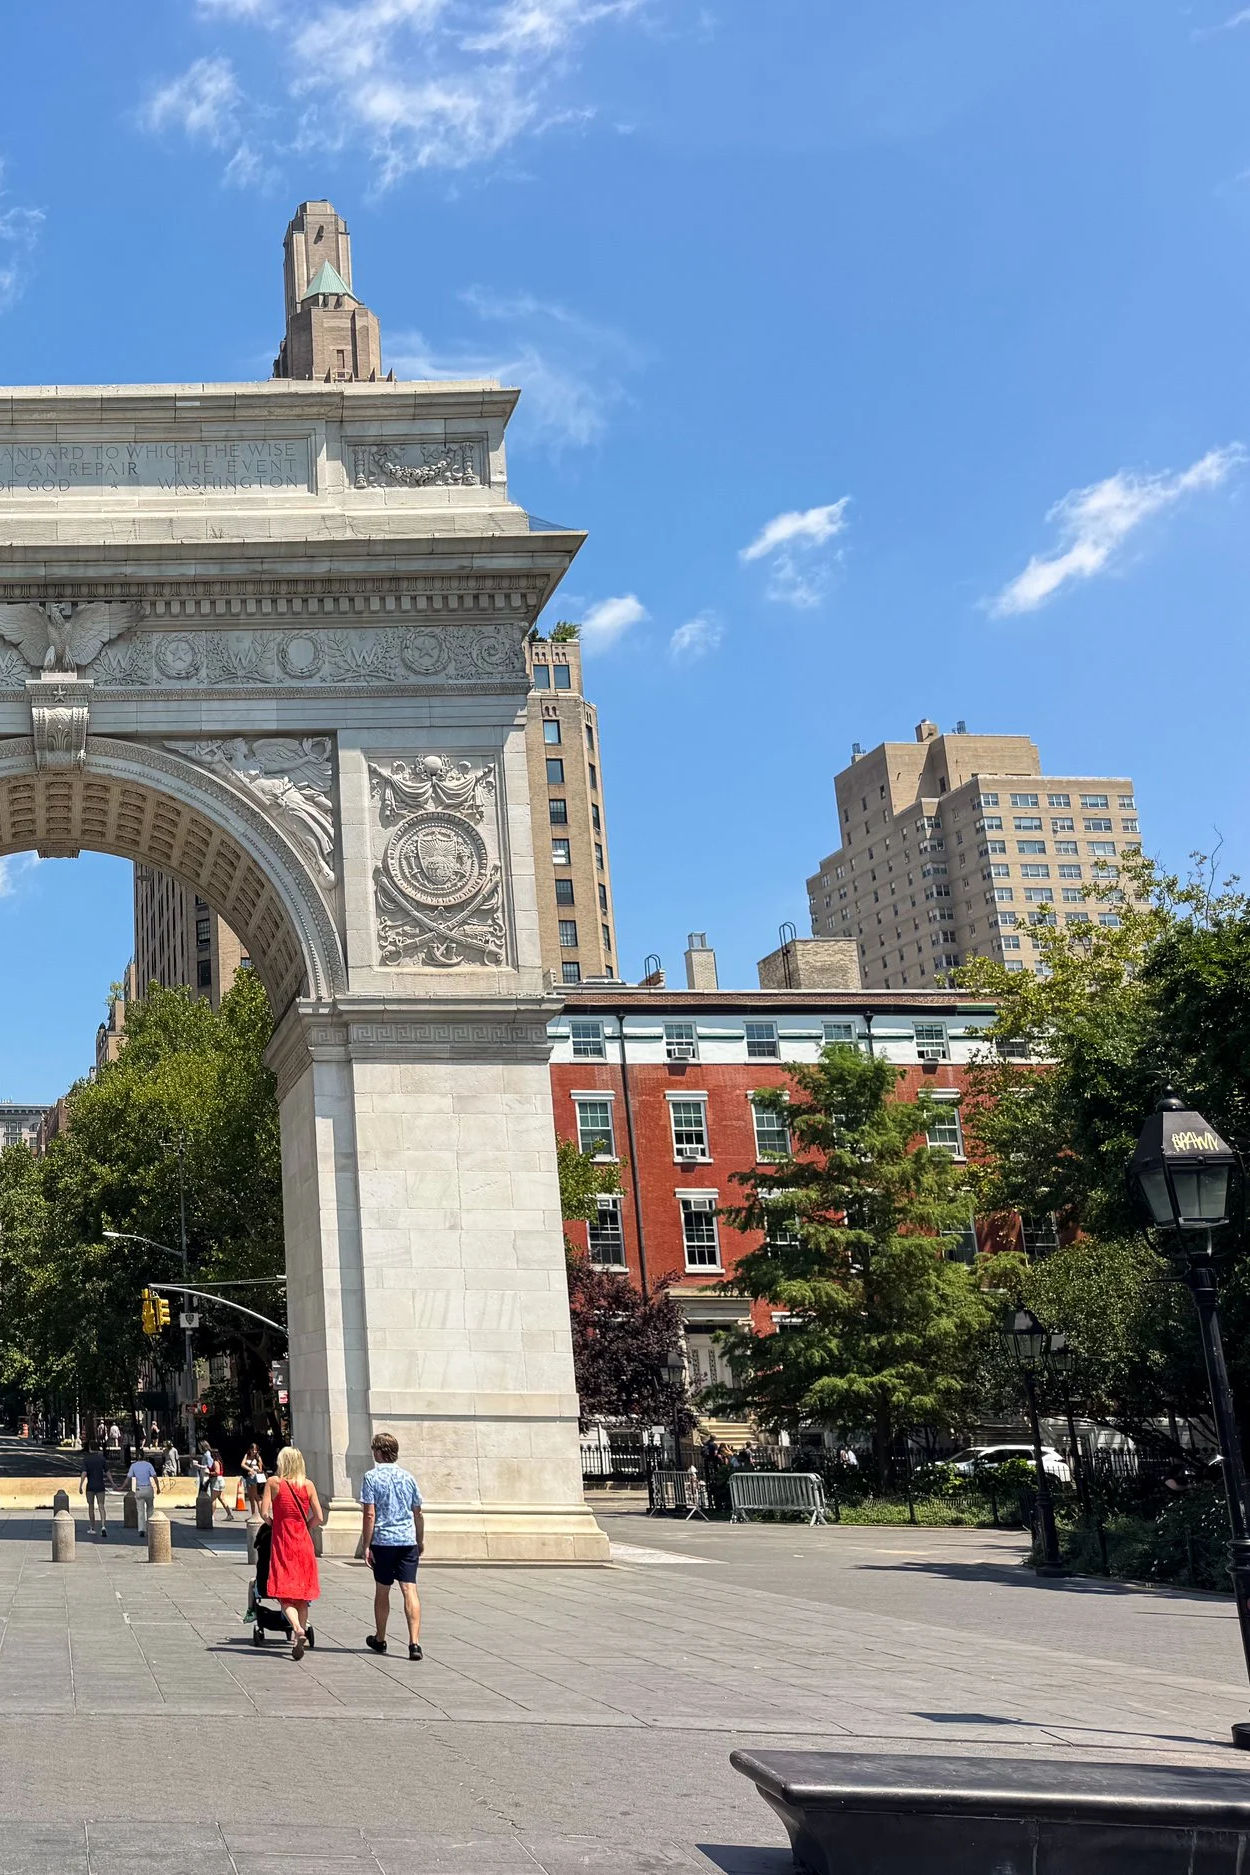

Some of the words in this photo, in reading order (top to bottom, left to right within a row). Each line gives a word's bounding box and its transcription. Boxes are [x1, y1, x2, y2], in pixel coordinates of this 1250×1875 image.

[92, 446, 119, 460] TO
[126, 445, 193, 459] WHICH
[200, 444, 240, 458] THE
[247, 443, 296, 457] WISE
[14, 463, 58, 477] CAN
[69, 462, 139, 476] REPAIR
[175, 460, 214, 475] THE
[226, 459, 297, 474] EVENT
[27, 478, 70, 492] GOD
[157, 475, 298, 490] WASHINGTON
